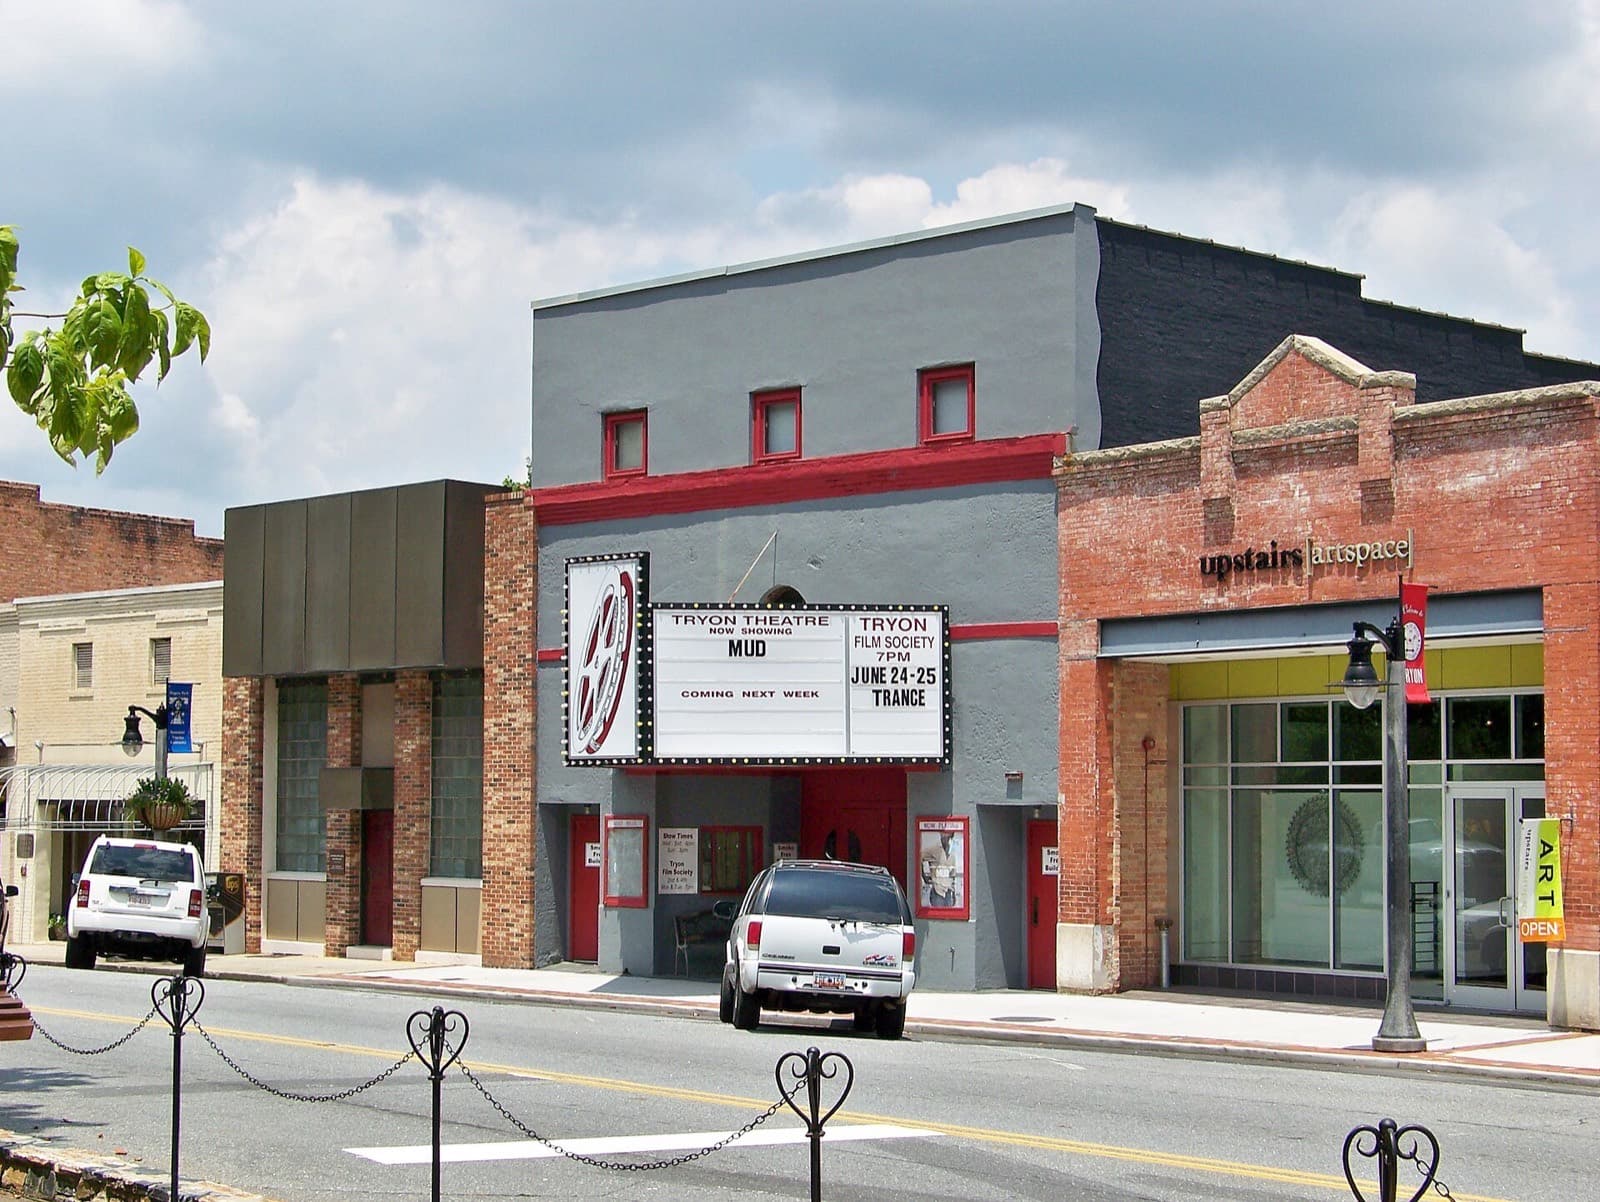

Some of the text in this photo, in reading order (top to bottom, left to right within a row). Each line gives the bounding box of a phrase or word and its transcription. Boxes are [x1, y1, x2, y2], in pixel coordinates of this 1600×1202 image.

[1200, 540, 1302, 582] upstairs
[672, 615, 830, 627] TRYON THEATRE
[859, 617, 927, 632] TRYON
[709, 627, 792, 635] NOW SHOWING
[728, 639, 766, 657] MUD
[854, 635, 935, 649] FILM SOCIETY
[876, 651, 911, 662] 7PM
[851, 667, 936, 685] JUNE 24-25
[1406, 668, 1423, 684] RYON
[681, 690, 820, 698] COMING NEXT WEEK
[872, 689, 925, 706] TRANCE
[1538, 839, 1554, 906] ART
[1521, 922, 1558, 936] OPEN
